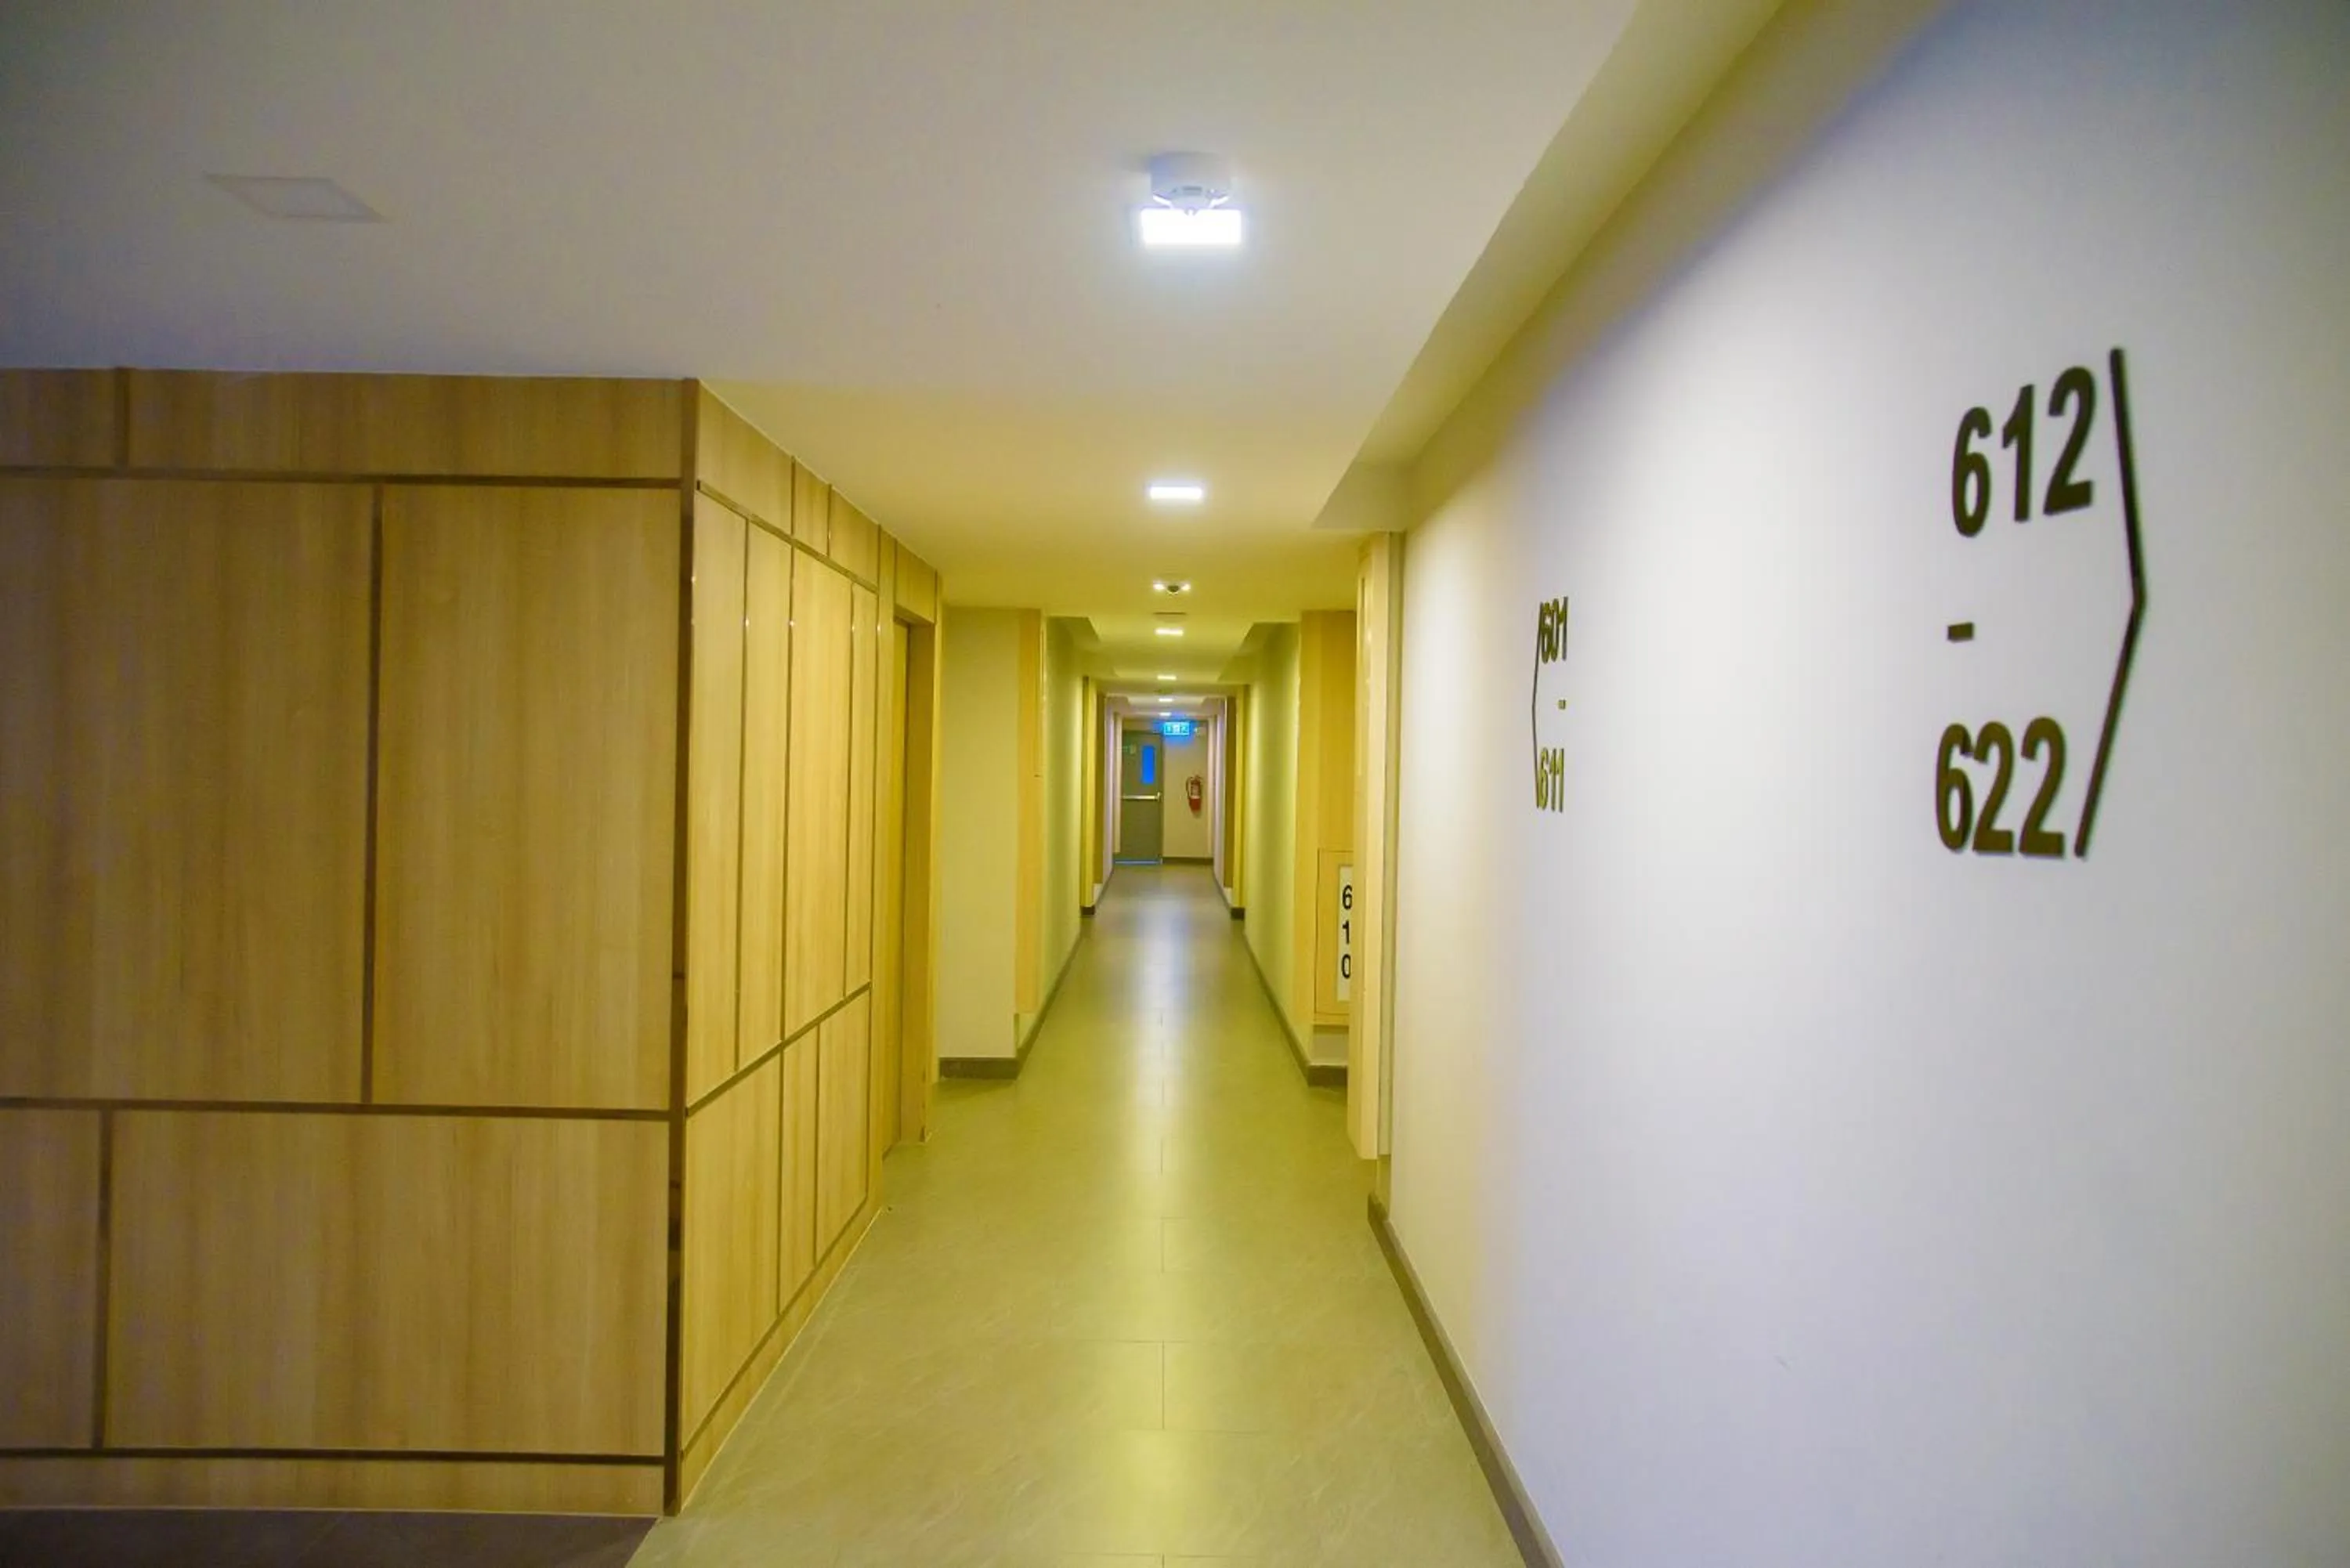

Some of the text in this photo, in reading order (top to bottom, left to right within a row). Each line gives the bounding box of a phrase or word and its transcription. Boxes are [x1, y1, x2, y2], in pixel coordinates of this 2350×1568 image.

[1952, 366, 2095, 537] 612
[1540, 596, 1568, 663] 601
[1538, 746, 1564, 812] 611
[1936, 716, 2067, 858] 622
[1341, 884, 1353, 978] 610
